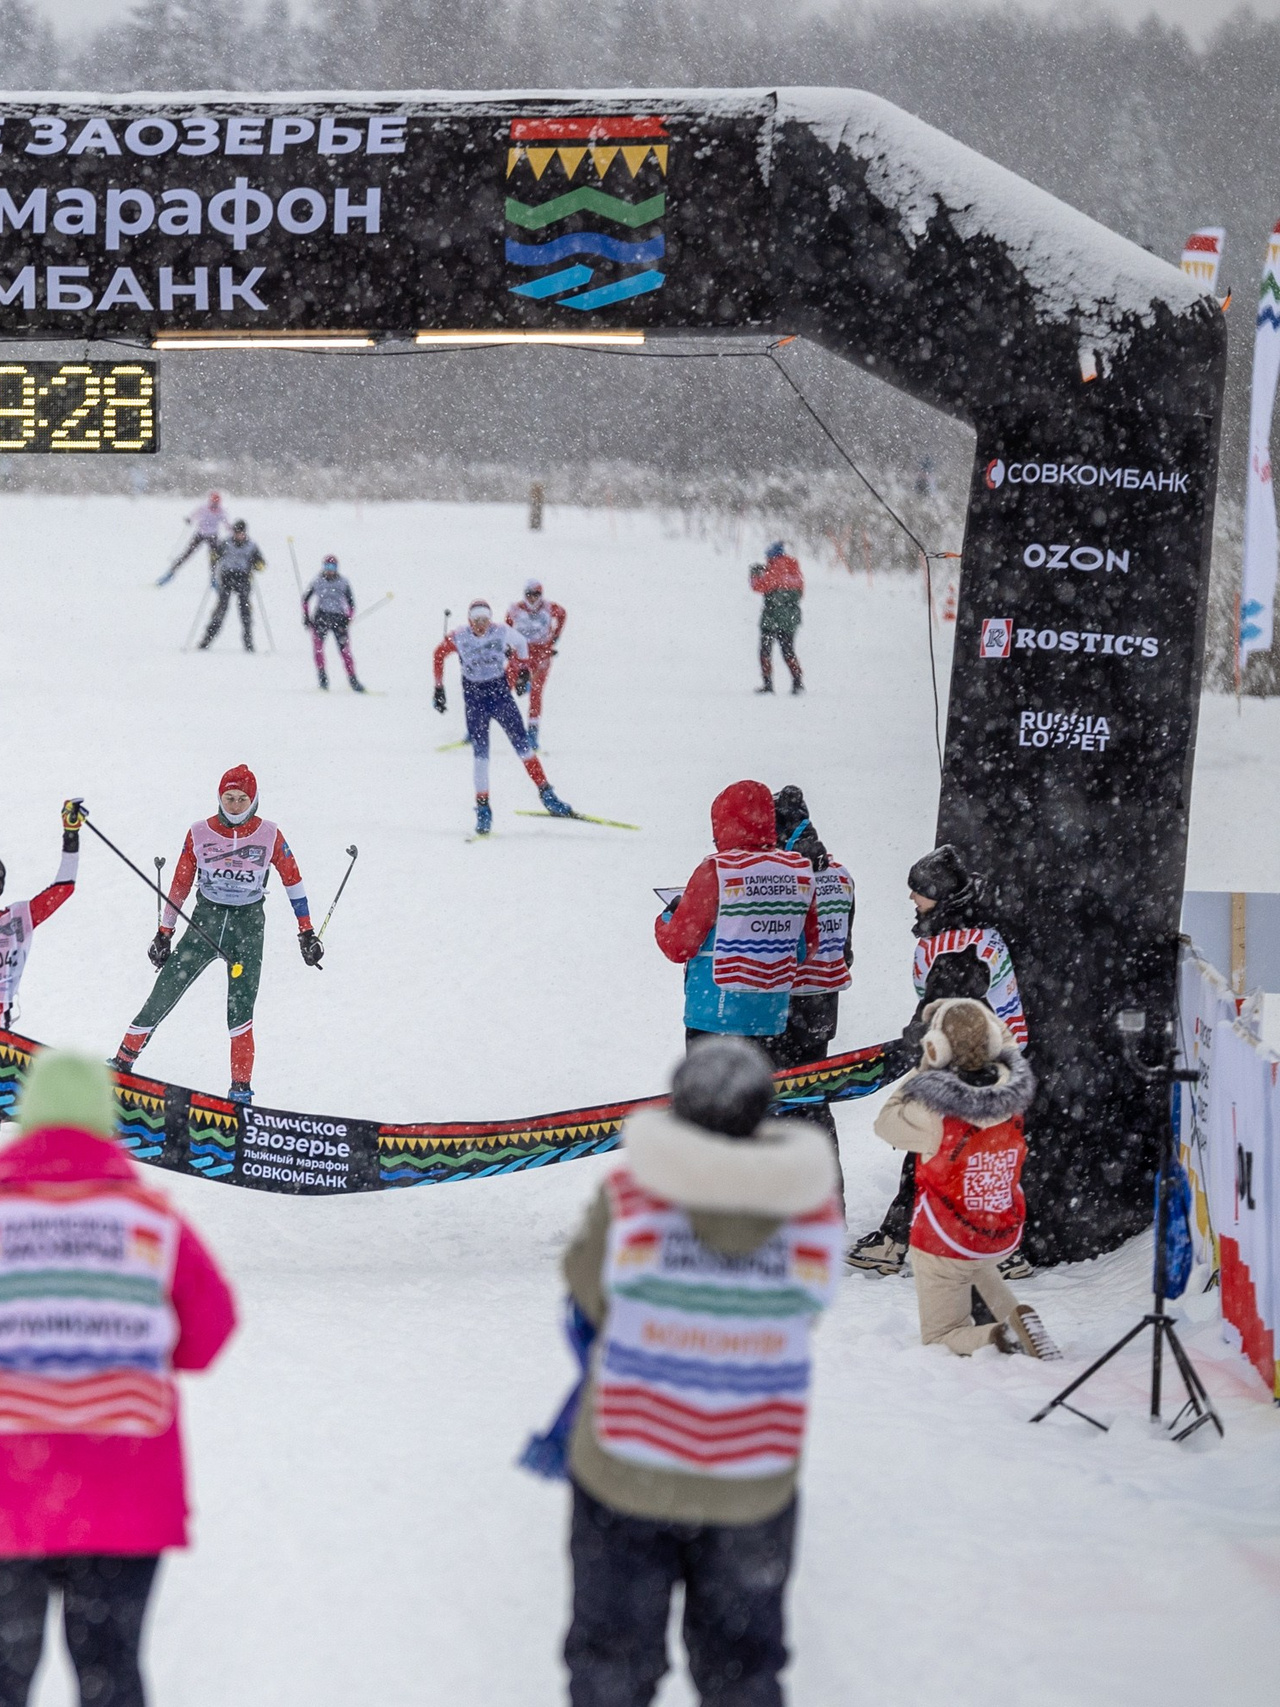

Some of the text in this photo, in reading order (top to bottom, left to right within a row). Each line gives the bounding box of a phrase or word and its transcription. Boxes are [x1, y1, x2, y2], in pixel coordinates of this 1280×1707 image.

[25, 115, 408, 156] ЗАОЗЕРЬЕ
[1008, 463, 1188, 493] СОВКОМБАНК
[1023, 543, 1130, 573] OZON
[1015, 628, 1159, 657] ROSTIC'S
[1021, 711, 1110, 735] RUSSIA
[1019, 730, 1110, 752] LOPPET
[745, 874, 796, 885] ГАЛИЧСКОЕ
[746, 884, 798, 896] ЗАОЗЕРЬЕ
[751, 920, 791, 934] СУДЬЯ
[243, 1107, 348, 1137] Галичское
[243, 1125, 350, 1158] Заозерье
[243, 1149, 349, 1172] лыжный марафон
[242, 1162, 348, 1189] СОВКОМБАНК
